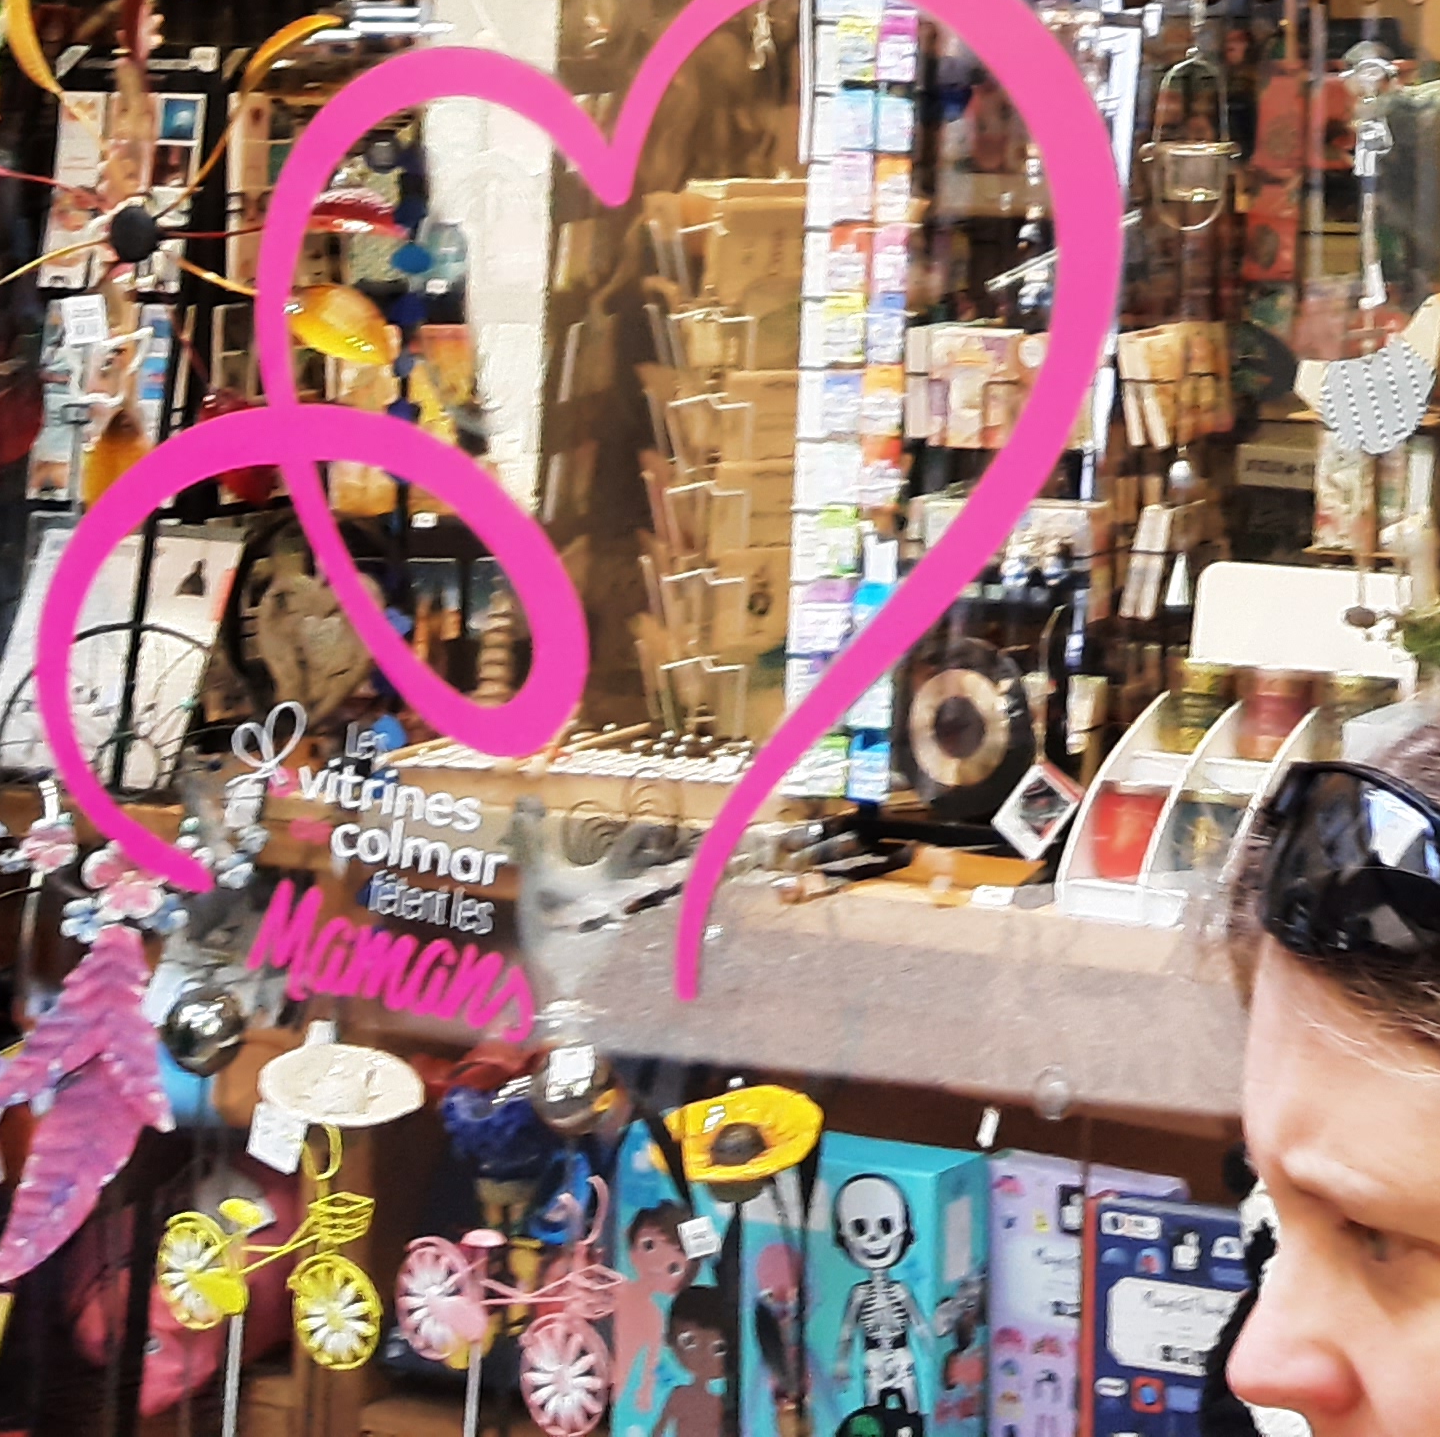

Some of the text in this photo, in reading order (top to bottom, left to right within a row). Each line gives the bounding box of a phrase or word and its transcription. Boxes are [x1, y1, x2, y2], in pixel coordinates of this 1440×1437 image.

[297, 757, 484, 833] vitrines
[330, 818, 509, 887] colmar
[367, 869, 497, 936] fêtent les
[245, 877, 537, 1044] Mamans
